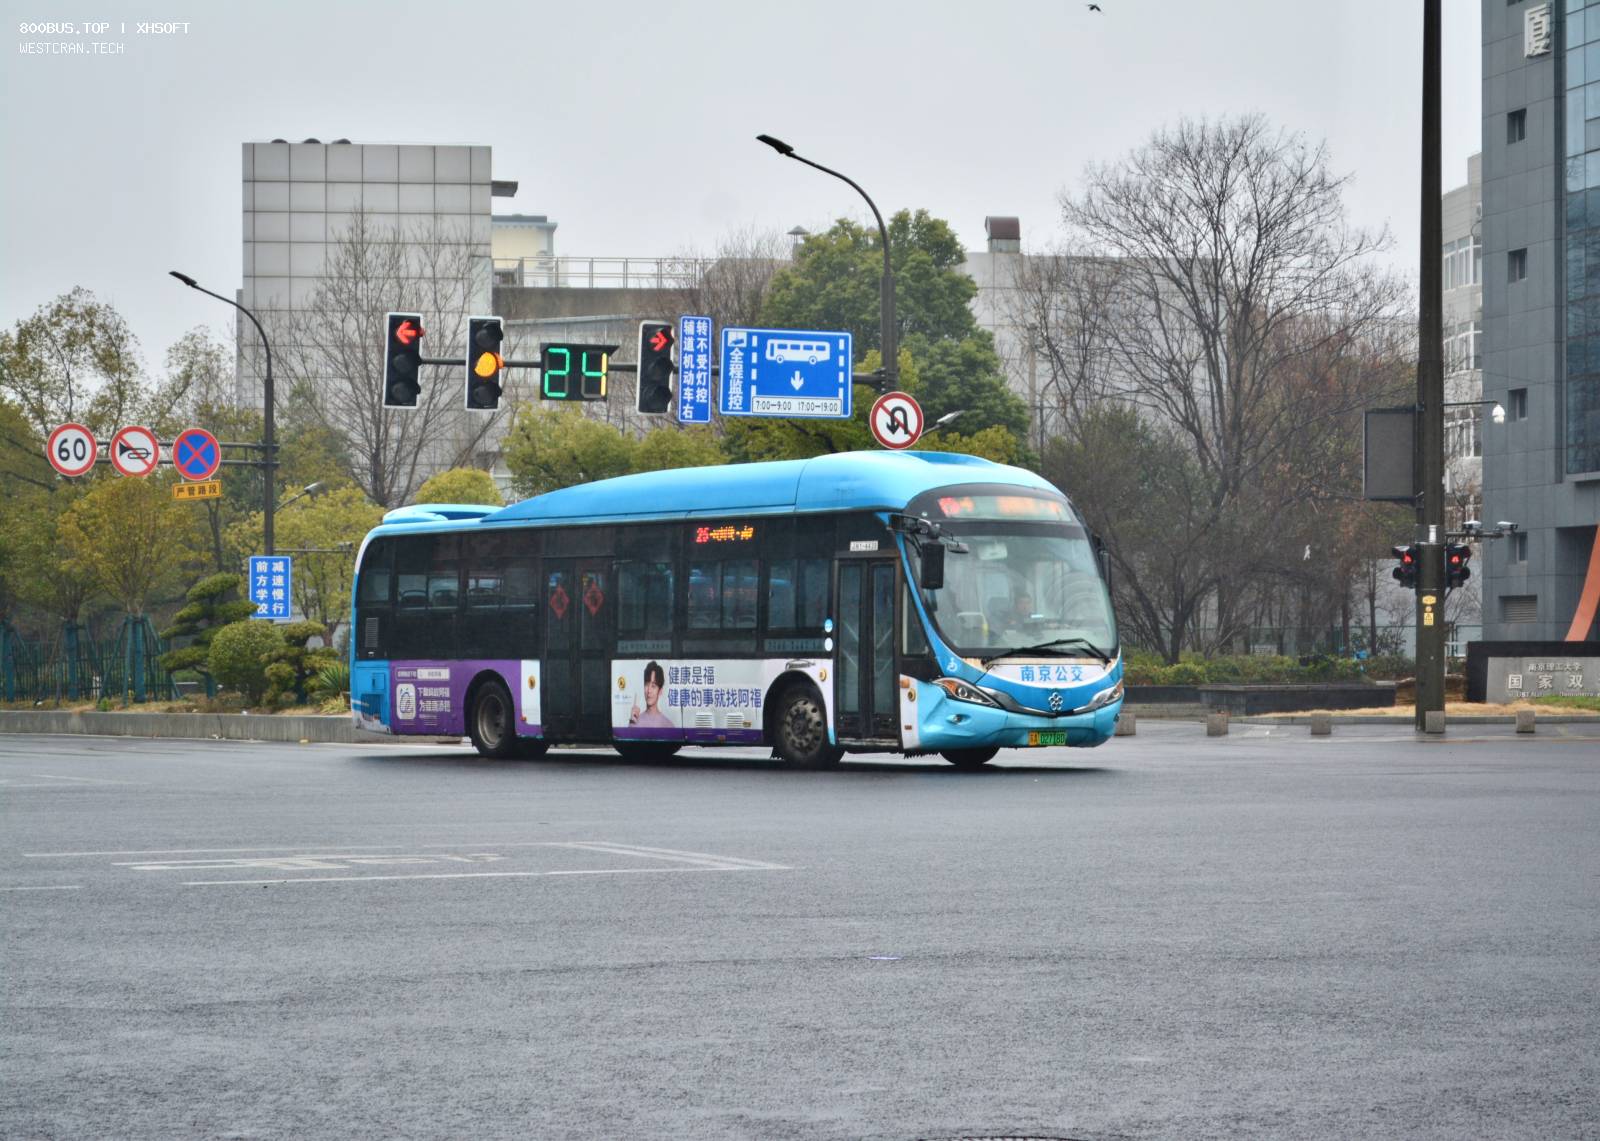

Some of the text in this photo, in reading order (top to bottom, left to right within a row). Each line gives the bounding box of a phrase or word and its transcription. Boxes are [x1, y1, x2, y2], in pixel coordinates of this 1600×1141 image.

[1524, 3, 1552, 58] 厦
[544, 347, 608, 398] 24
[682, 320, 695, 419] 辅道机动车右
[696, 320, 708, 403] 转不受灯控
[728, 347, 744, 410] 全程监控
[57, 438, 87, 461] 60
[176, 484, 217, 497] 严管路段
[255, 560, 269, 615] 前方学校
[271, 560, 285, 615] 减速慢行
[667, 688, 762, 707] 健康的事就找阿福
[668, 666, 715, 685] 健康是福
[1020, 665, 1083, 682] 南京公交
